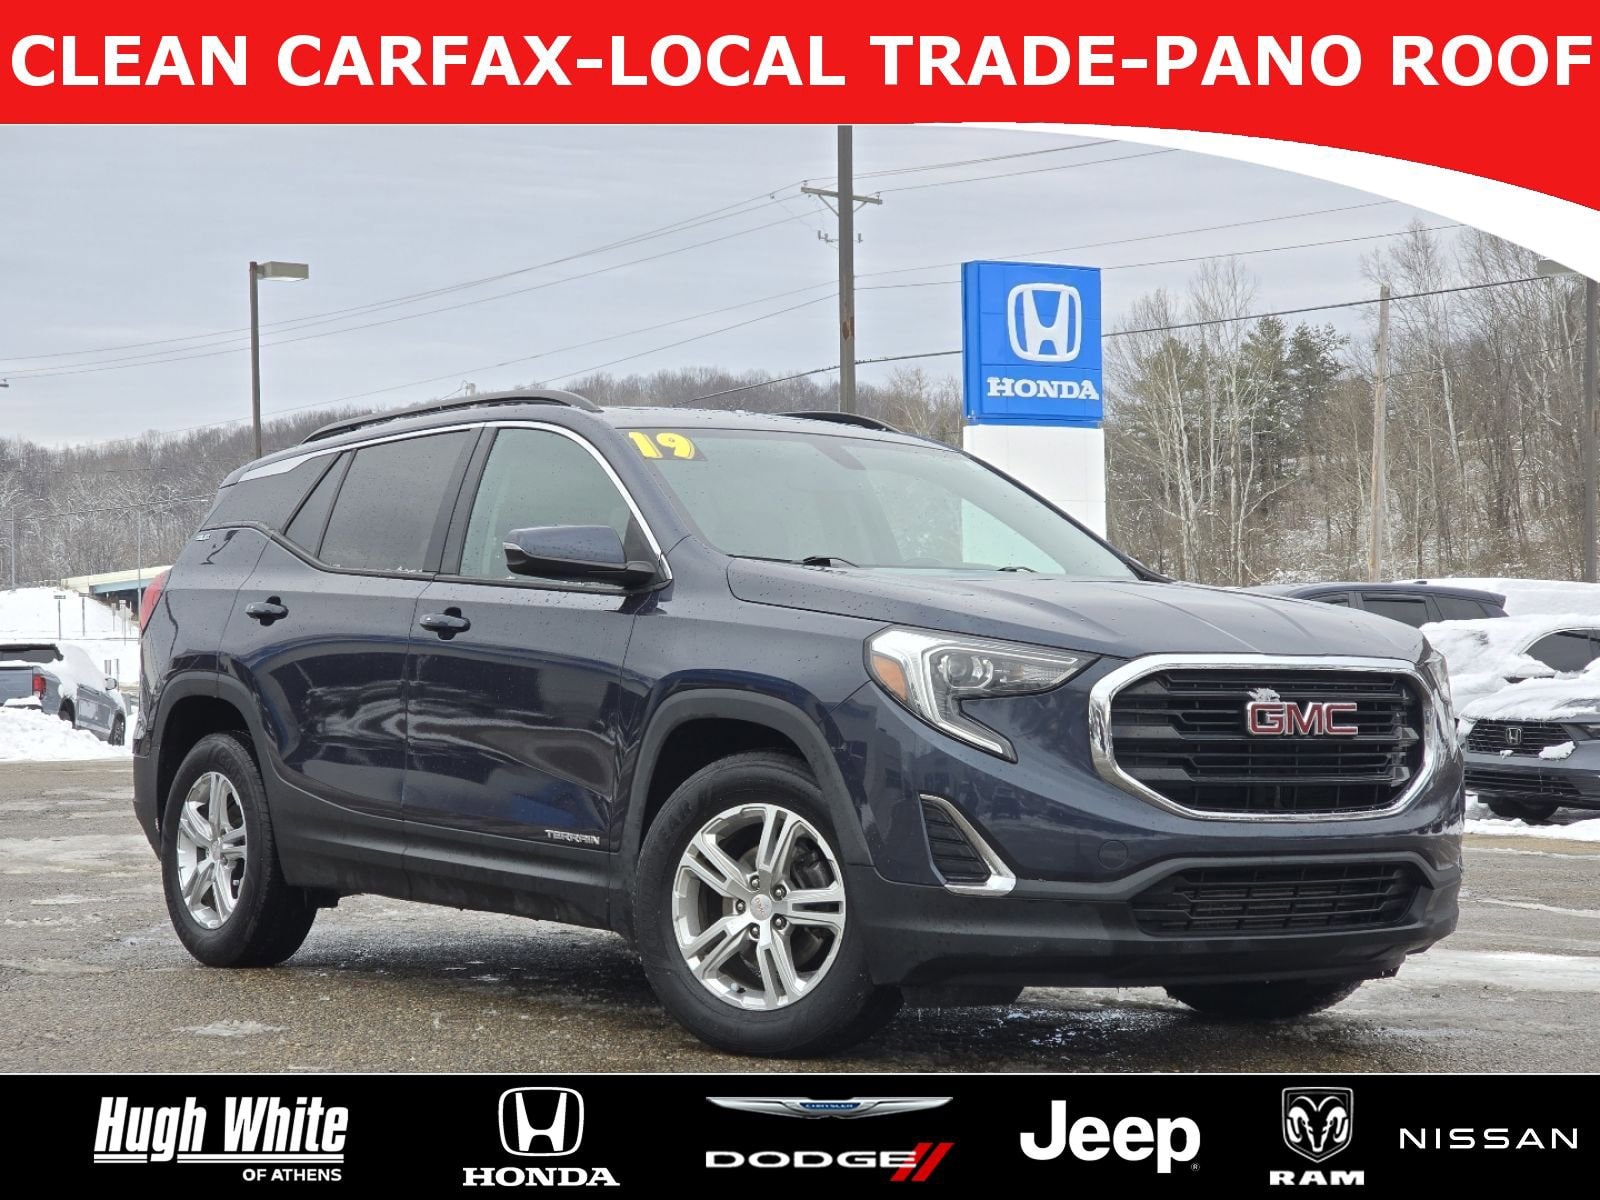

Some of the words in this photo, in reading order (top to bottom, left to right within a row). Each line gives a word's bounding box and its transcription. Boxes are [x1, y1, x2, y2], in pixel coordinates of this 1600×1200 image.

[986, 376, 1100, 401] HONDA
[628, 431, 695, 460] 19
[1246, 701, 1359, 736] GMC
[544, 829, 600, 845] TERRAIN
